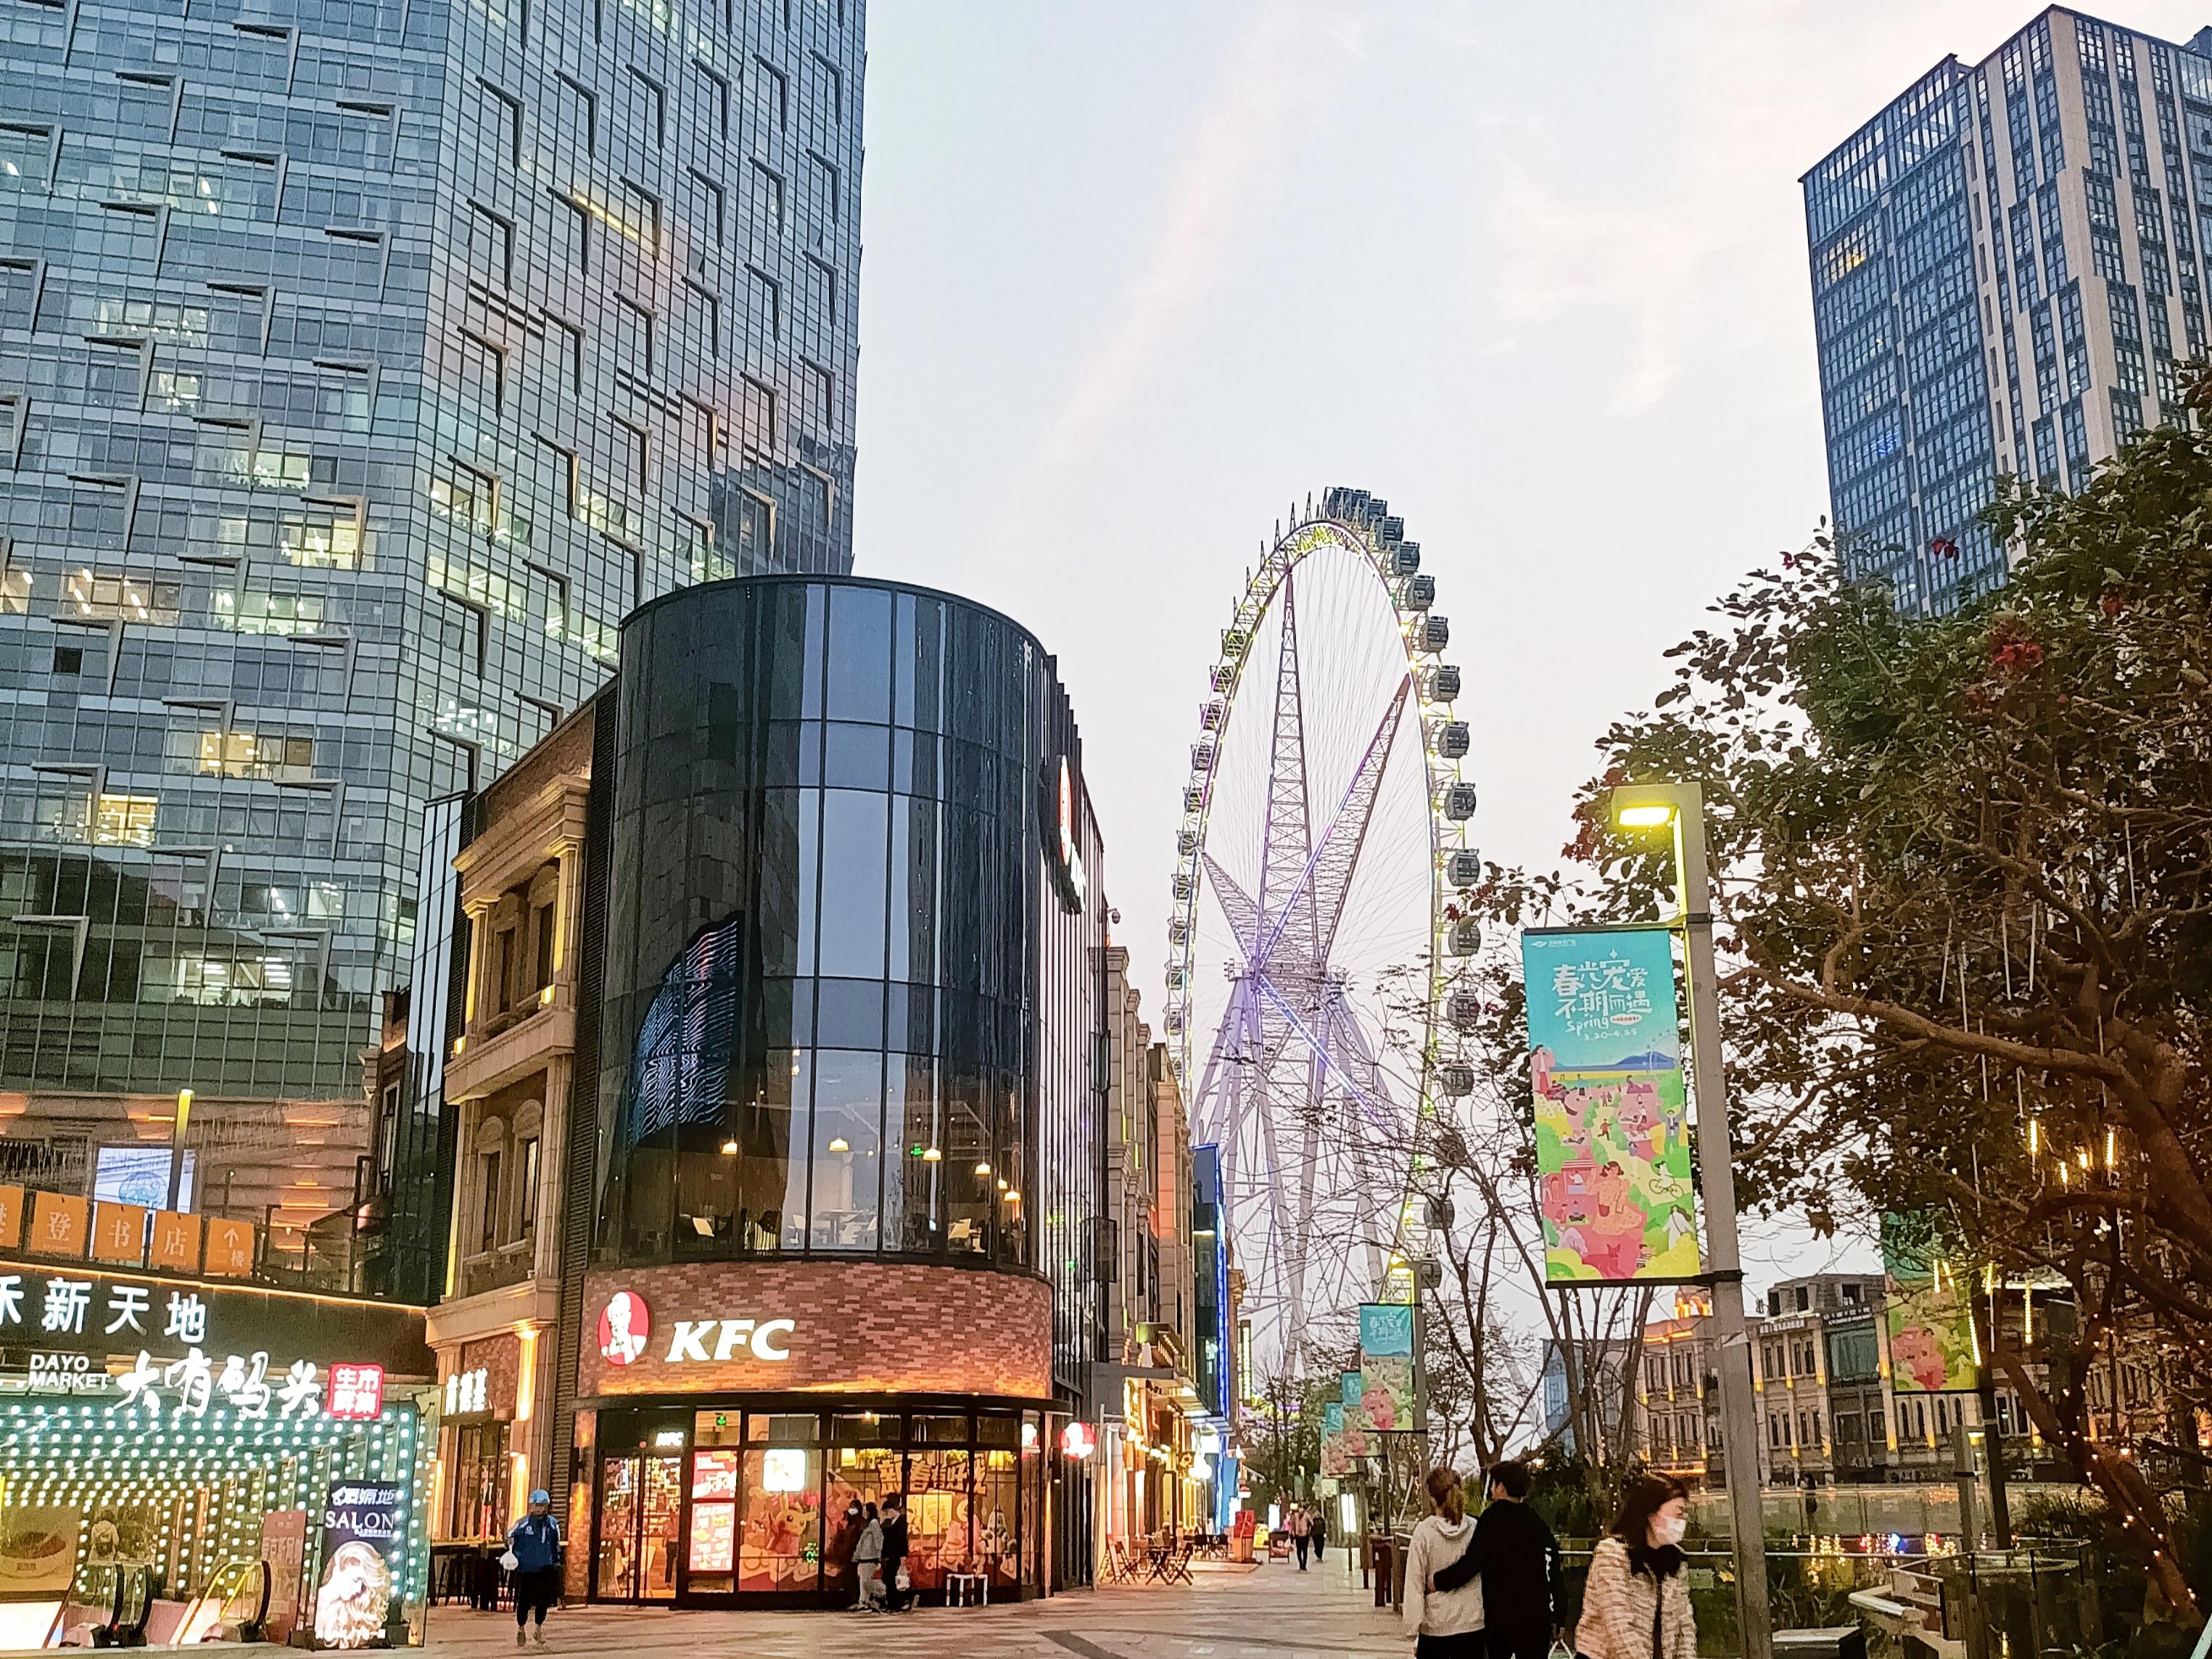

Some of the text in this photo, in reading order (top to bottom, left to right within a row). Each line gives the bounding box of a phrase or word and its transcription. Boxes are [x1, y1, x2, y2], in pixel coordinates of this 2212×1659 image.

[1552, 959, 1648, 997] 春光宠爱
[1554, 989, 1654, 1019] 不期而遇
[0, 1203, 187, 1257] 登书店
[664, 1319, 796, 1362] KFC
[29, 1354, 90, 1371] DAYO
[28, 1371, 110, 1390] MARKET
[114, 1346, 322, 1419] 大有码头
[324, 1510, 395, 1529] SALON
